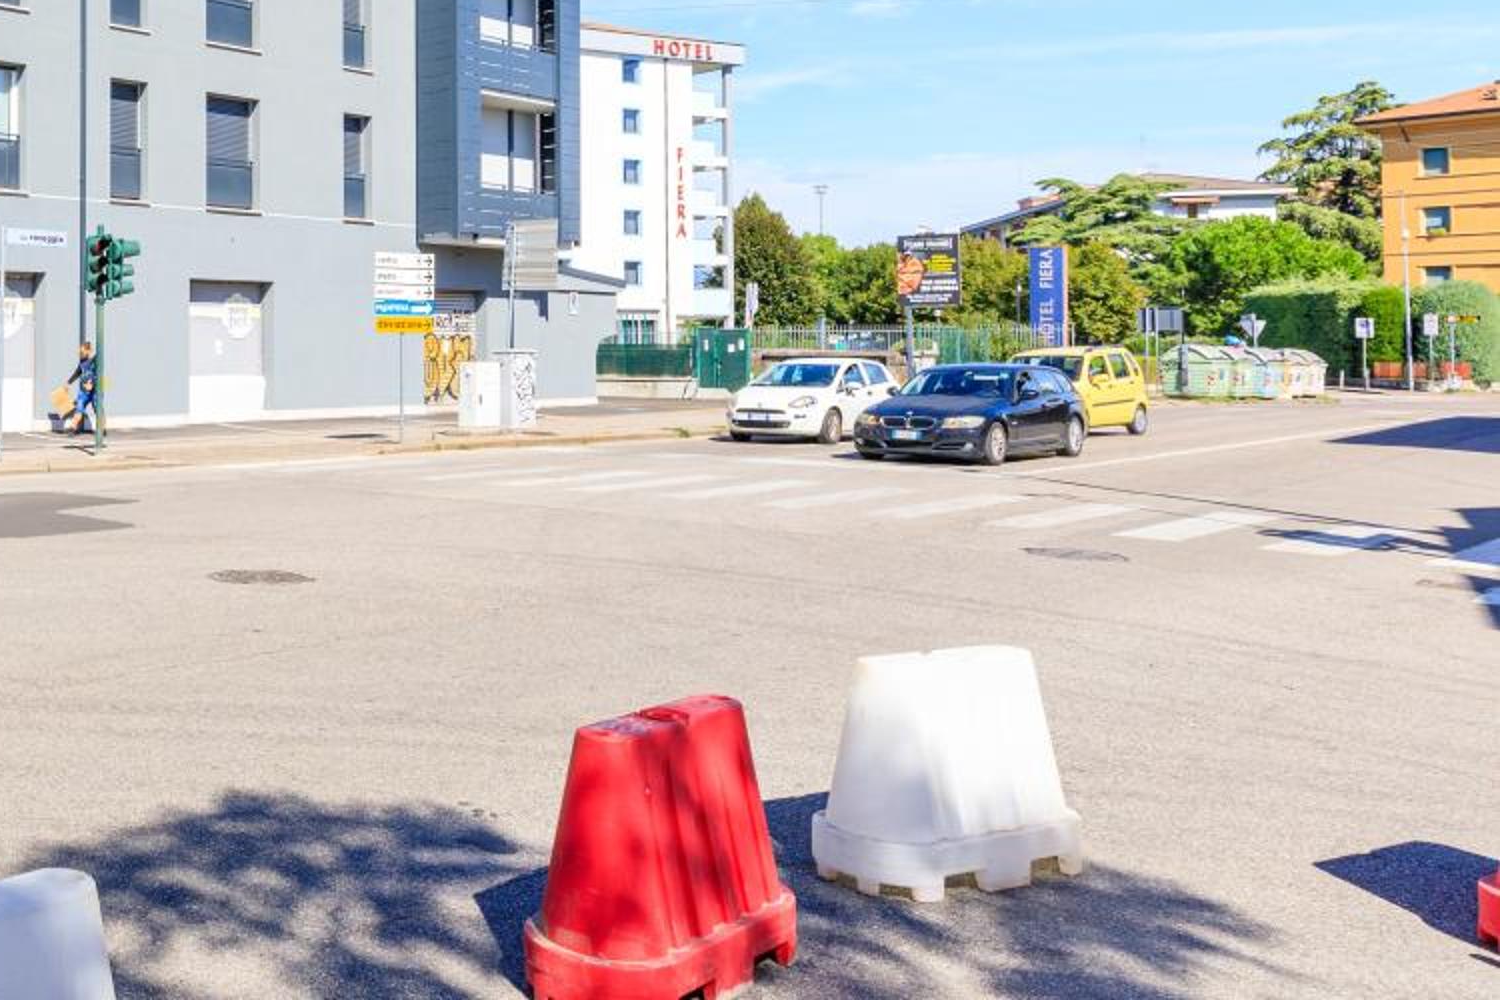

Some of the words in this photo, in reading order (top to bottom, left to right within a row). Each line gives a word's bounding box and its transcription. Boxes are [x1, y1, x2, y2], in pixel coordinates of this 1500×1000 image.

[653, 39, 713, 60] HOTEL
[675, 146, 687, 239] FIERA
[1038, 249, 1054, 289] FIERA
